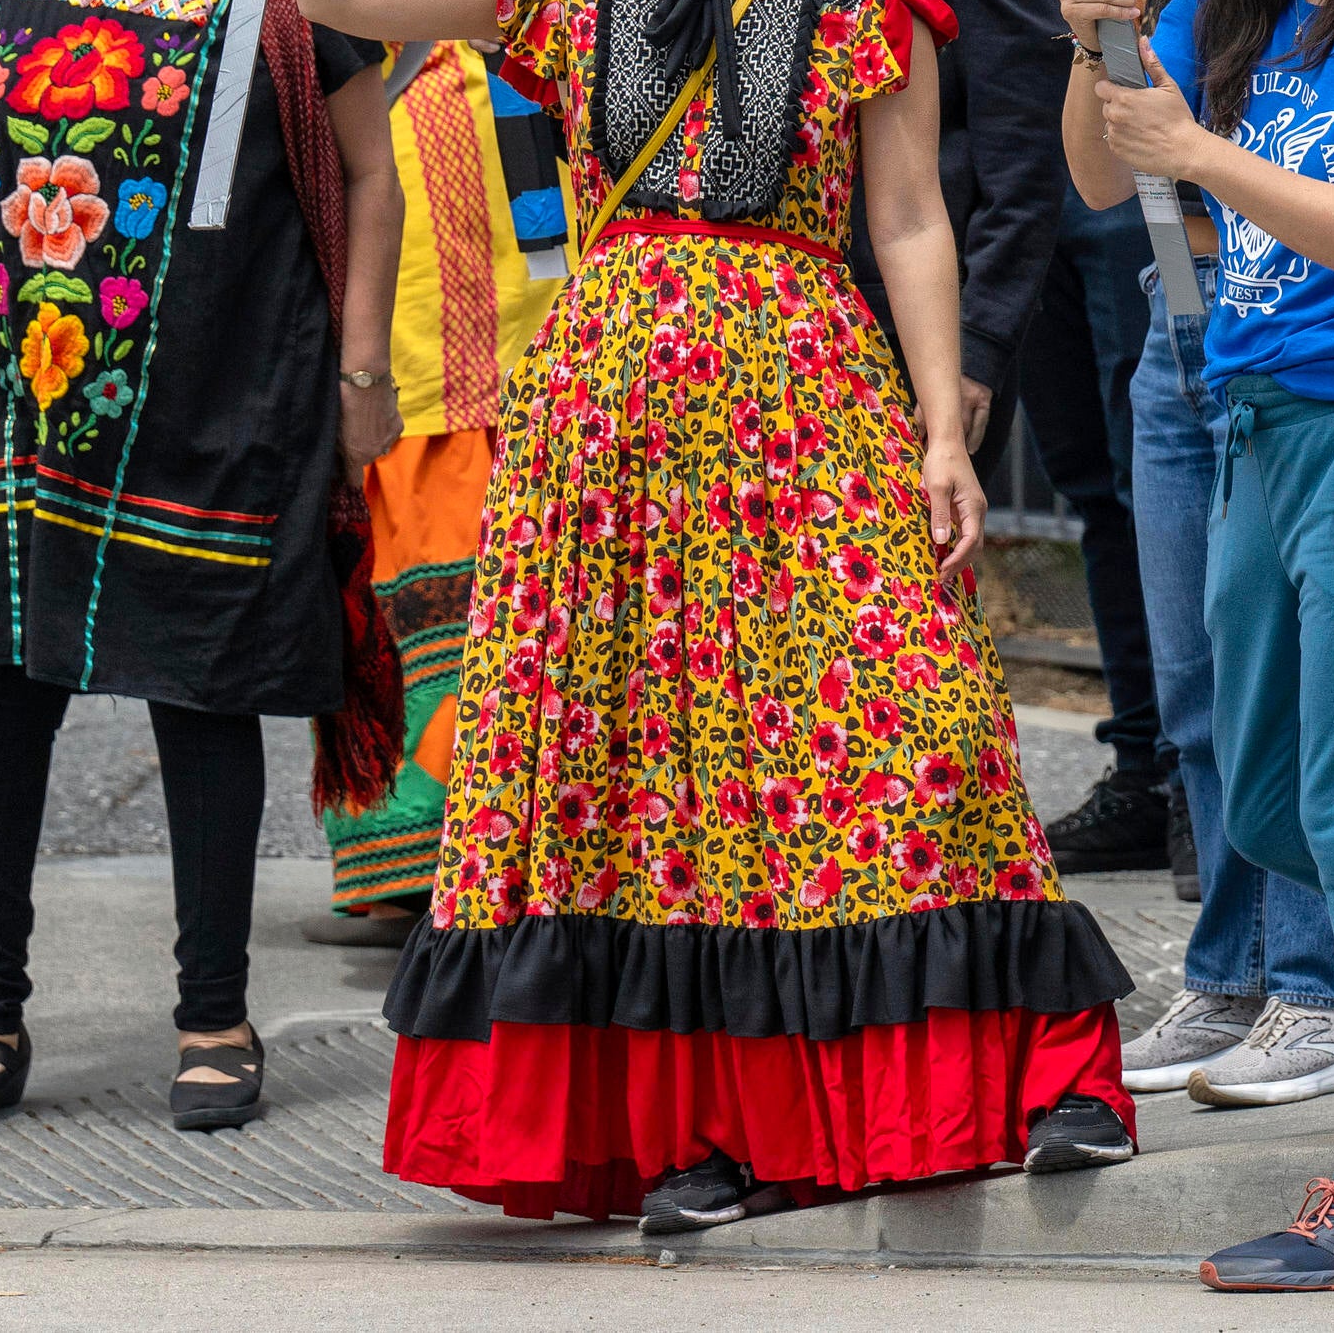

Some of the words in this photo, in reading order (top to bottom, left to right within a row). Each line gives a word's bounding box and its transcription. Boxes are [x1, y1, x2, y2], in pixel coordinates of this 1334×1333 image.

[1244, 71, 1302, 98] UILD
[1301, 83, 1319, 110] OF
[1227, 285, 1264, 301] WEST
